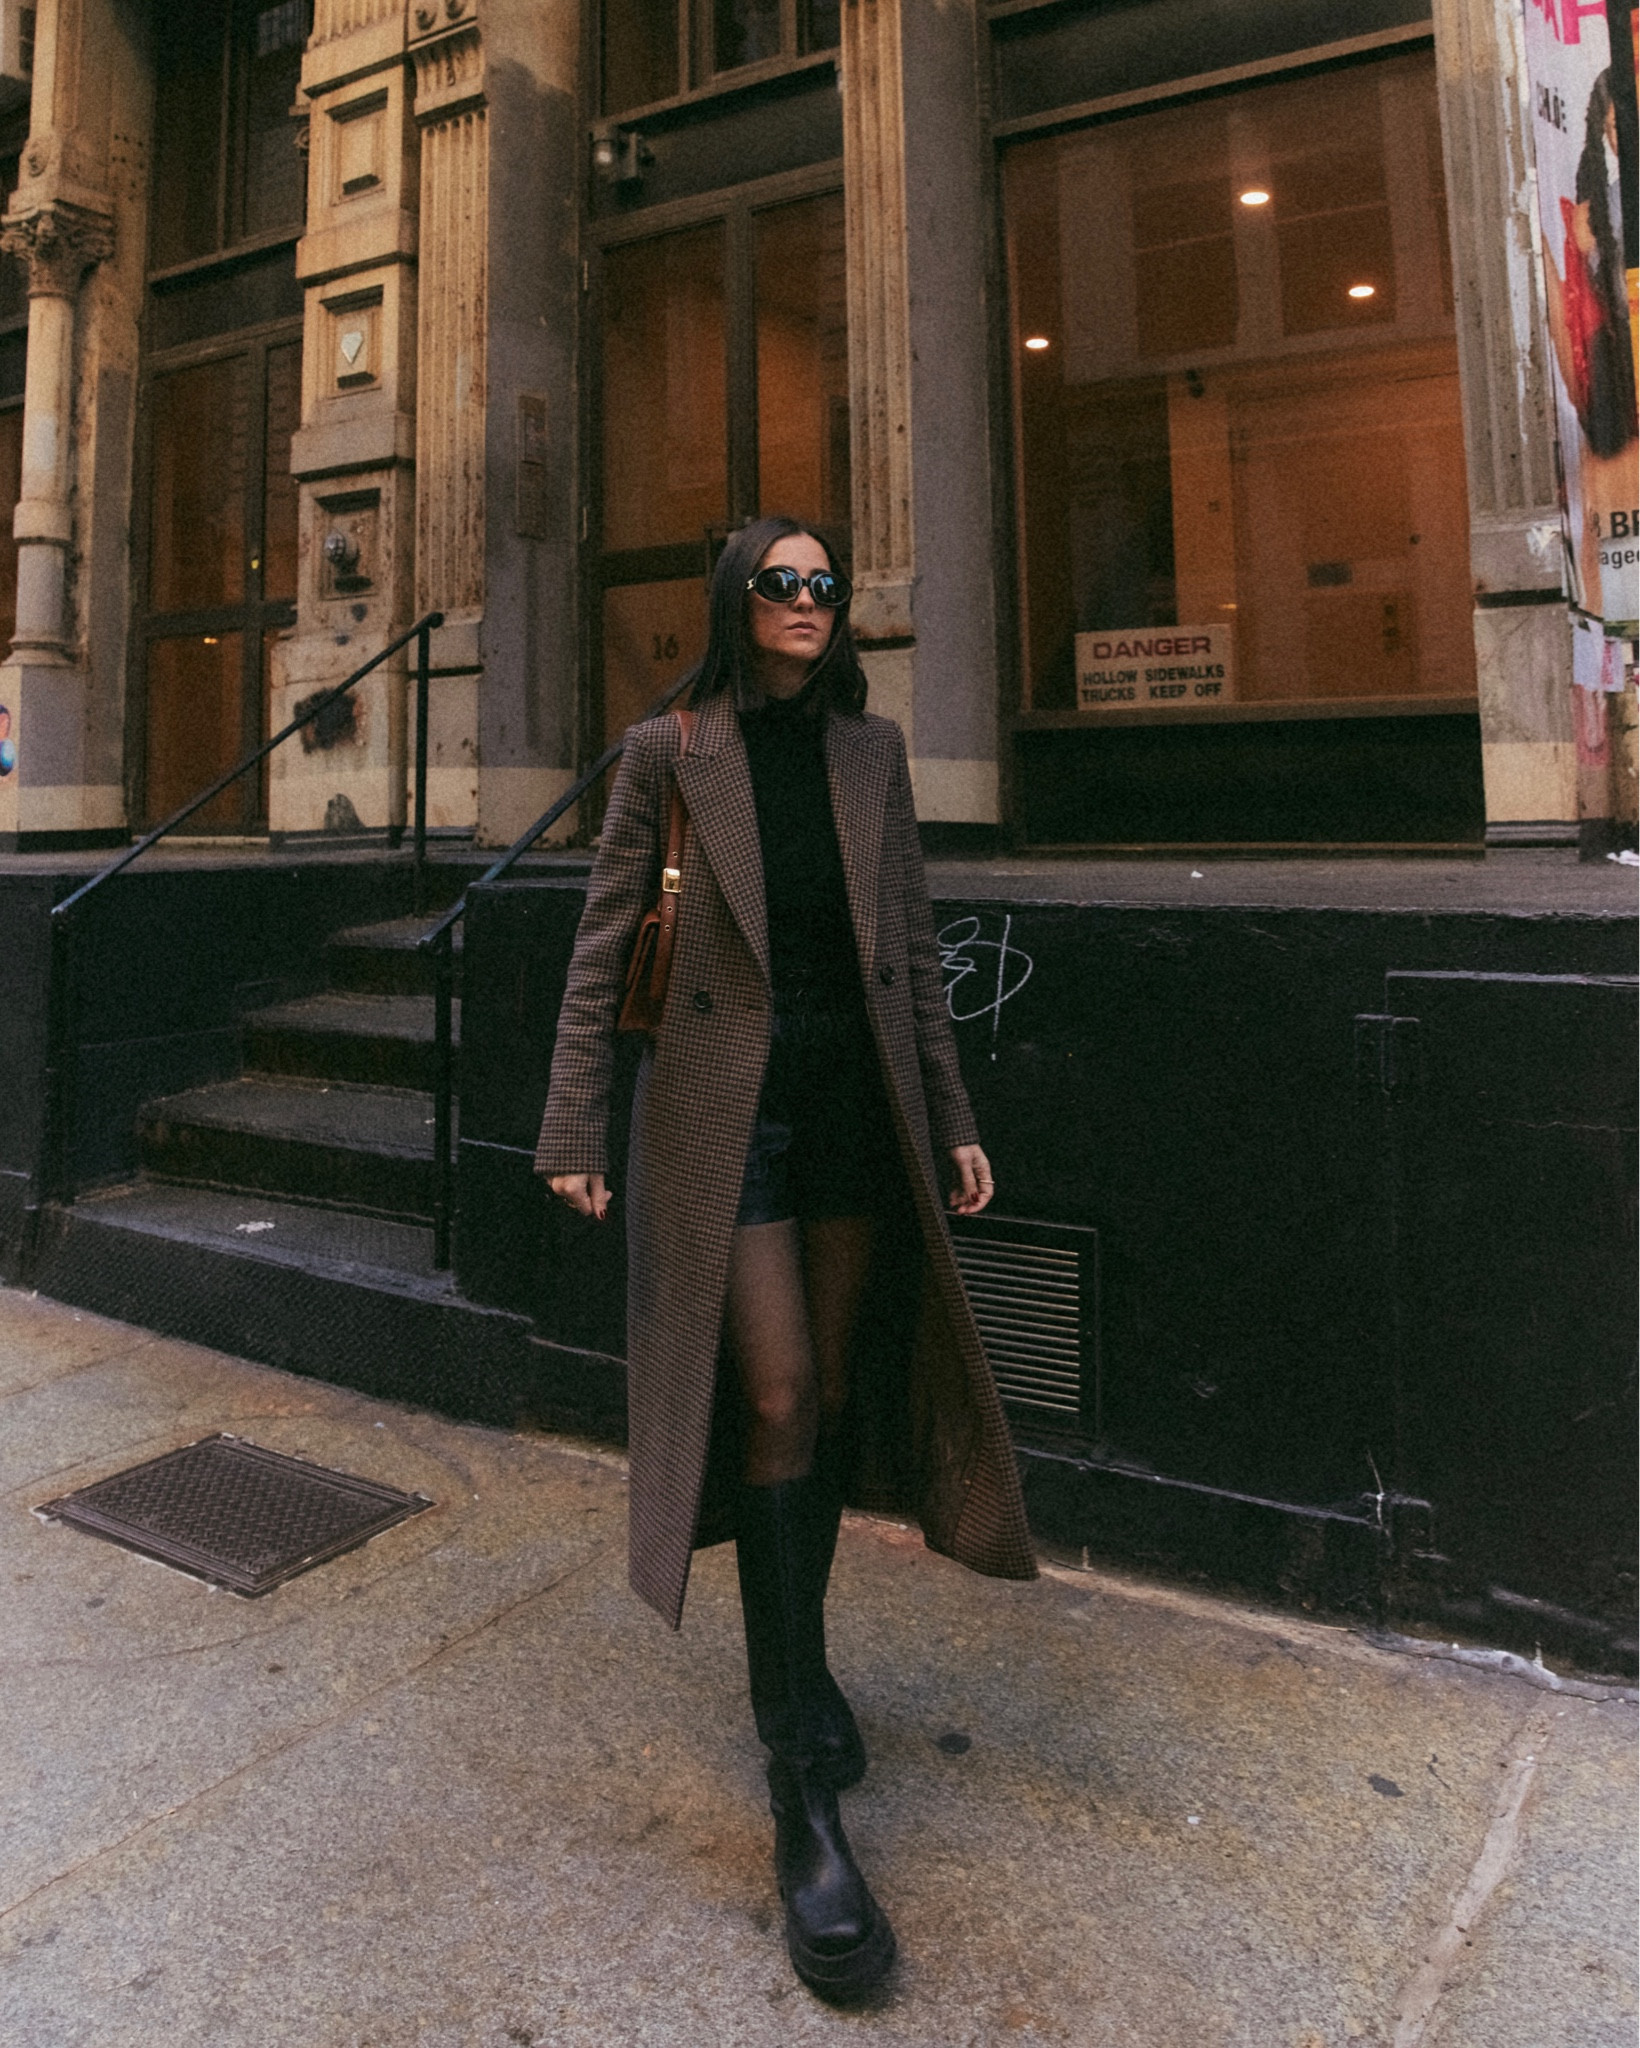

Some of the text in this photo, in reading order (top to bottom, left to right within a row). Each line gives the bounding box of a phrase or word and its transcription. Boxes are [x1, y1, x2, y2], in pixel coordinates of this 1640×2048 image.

[652, 634, 679, 660] 16
[1093, 636, 1212, 660] DANGER
[1083, 664, 1225, 686] HOLLOW SIDEWALKS
[1081, 682, 1222, 703] TRUCKS KEEP OFF
